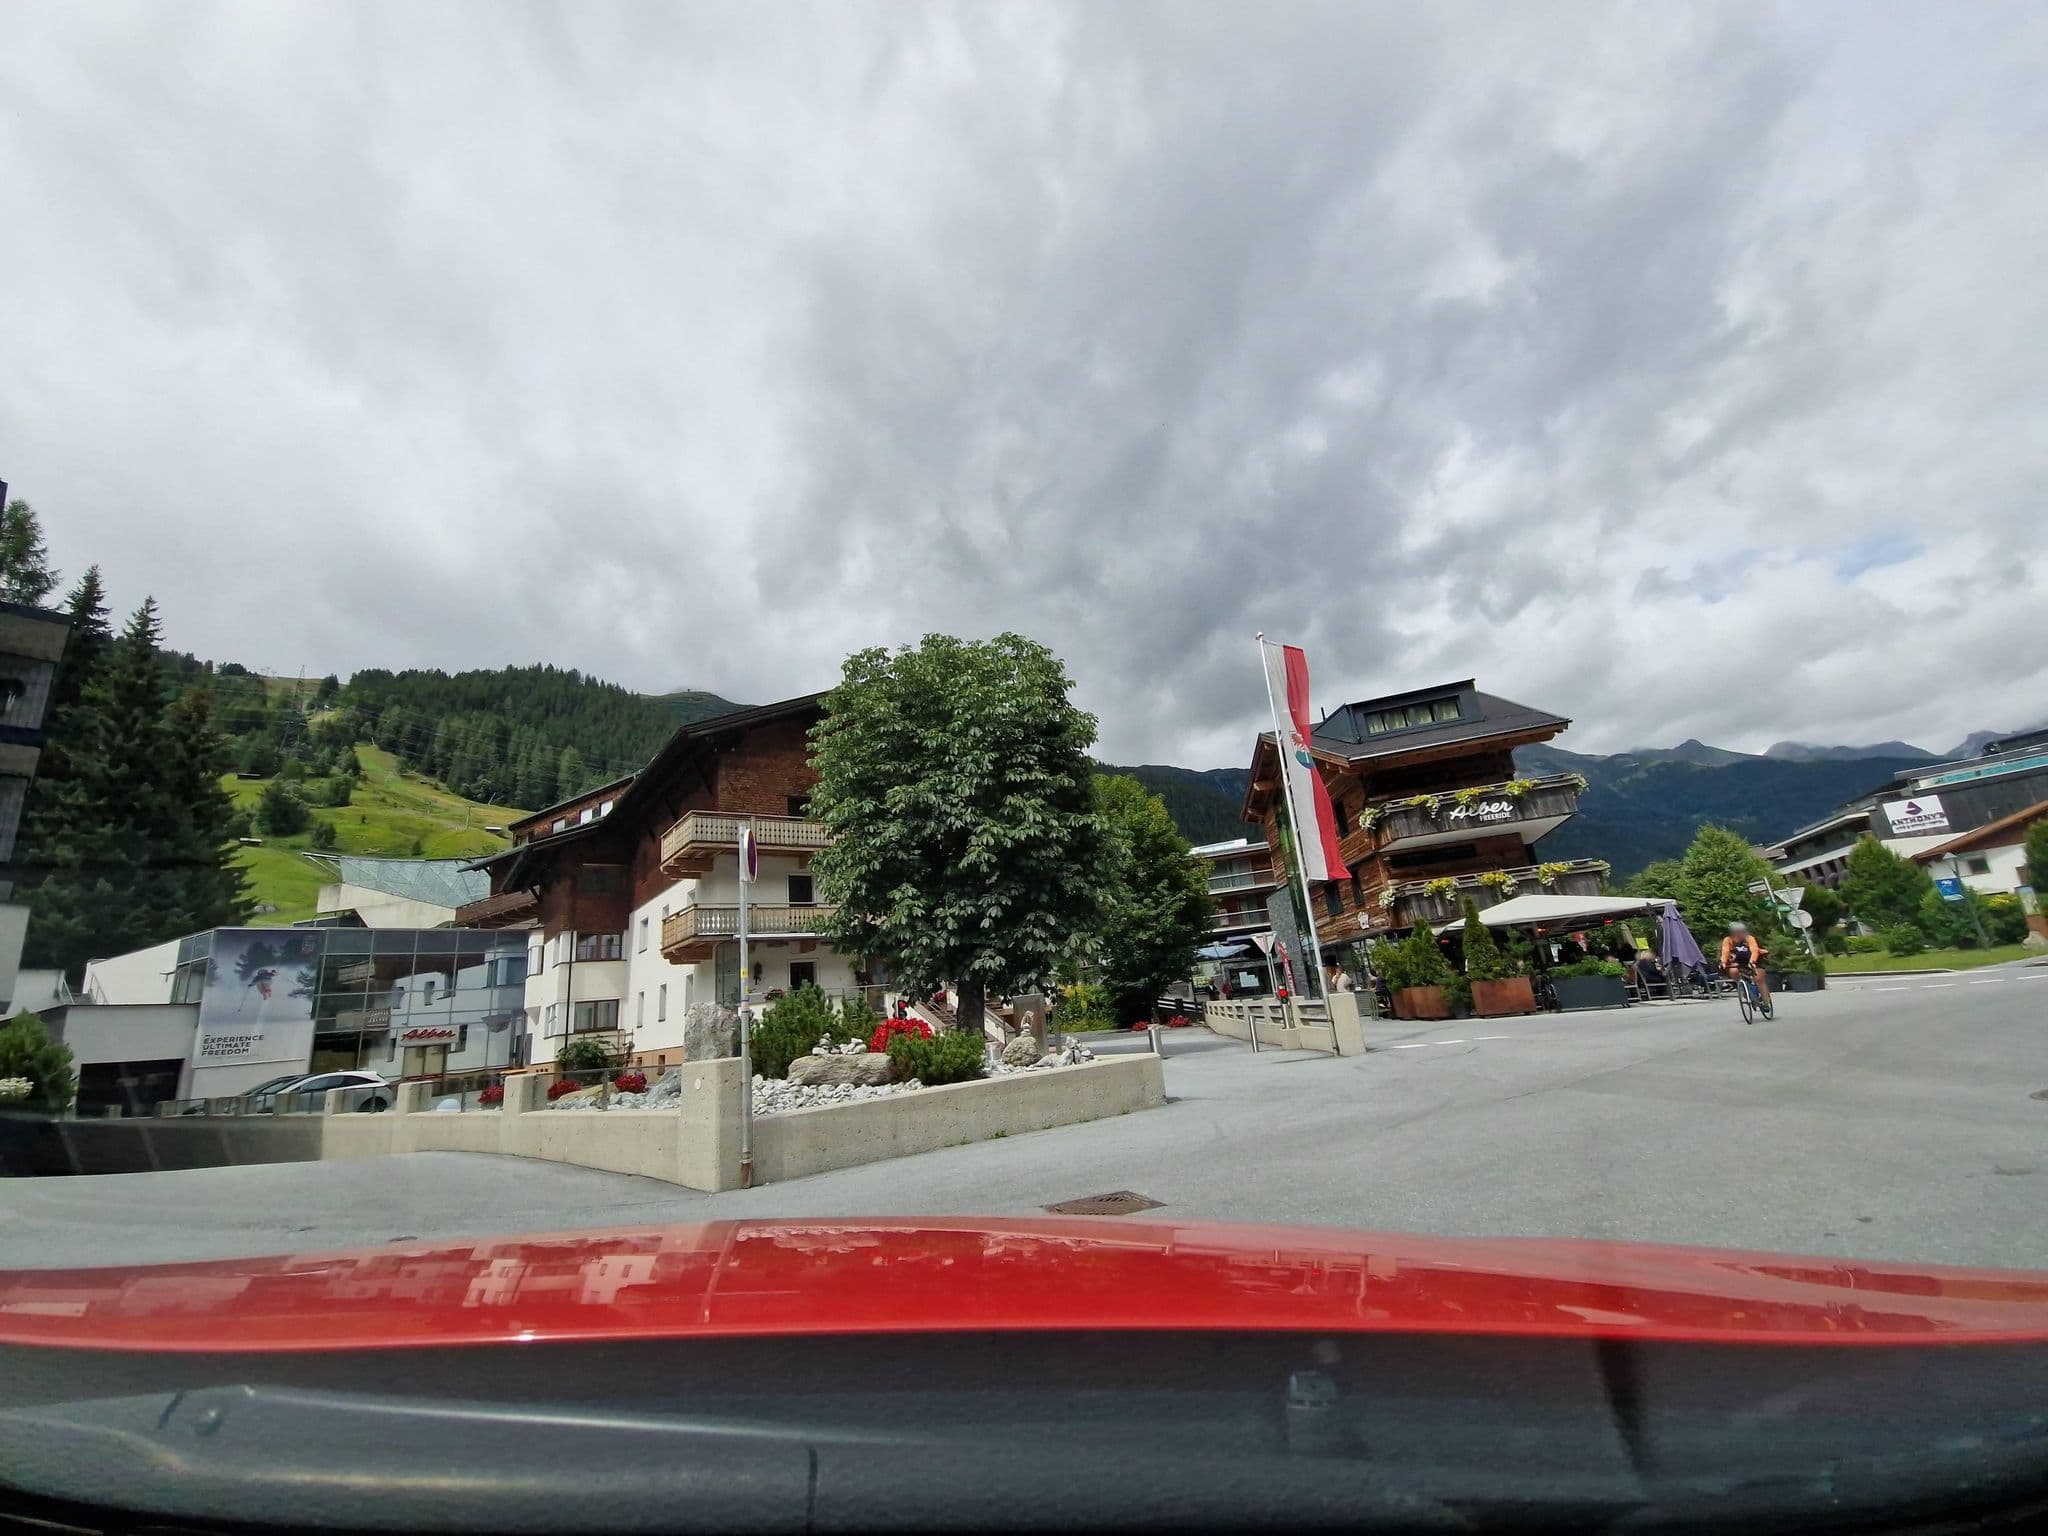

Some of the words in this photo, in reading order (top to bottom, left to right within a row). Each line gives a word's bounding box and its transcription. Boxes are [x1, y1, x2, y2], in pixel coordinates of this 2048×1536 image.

[1480, 811, 1511, 821] FREERIDE
[401, 1028, 456, 1041] Alber
[203, 1035, 265, 1044] EXPERIENCE
[202, 1042, 252, 1050] ULTIMATE
[201, 1048, 249, 1056] FREEDOM
